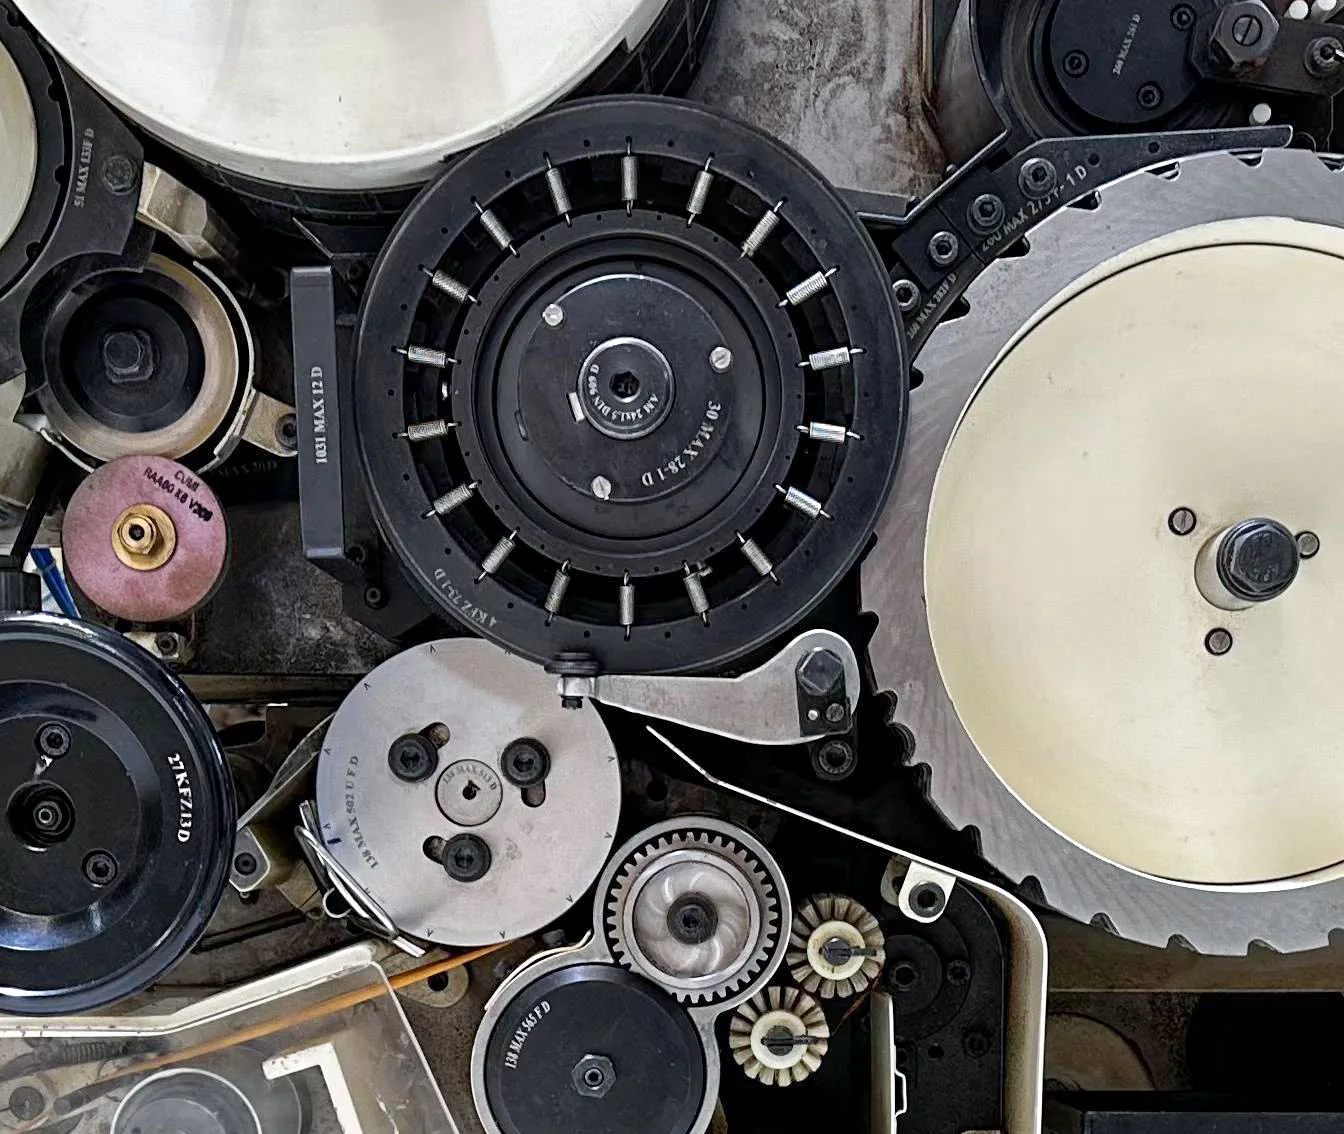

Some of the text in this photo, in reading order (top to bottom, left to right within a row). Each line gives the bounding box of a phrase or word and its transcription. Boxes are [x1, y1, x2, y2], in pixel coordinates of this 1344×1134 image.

[76, 164, 89, 193] MAX
[1075, 165, 1087, 180] D
[589, 364, 600, 376] D
[594, 395, 611, 416] DIN
[706, 400, 721, 420] 30
[310, 366, 328, 464] 1031 MAX 12 D
[683, 420, 714, 461] MAX
[641, 471, 655, 487] D
[434, 568, 447, 580] D
[349, 756, 359, 766] D
[346, 768, 356, 777] F
[348, 816, 367, 849] MAX
[362, 849, 379, 869] 138
[534, 1006, 542, 1019] F
[541, 1001, 550, 1013] D
[509, 1026, 528, 1054] MAX
[505, 1051, 518, 1069] 138
